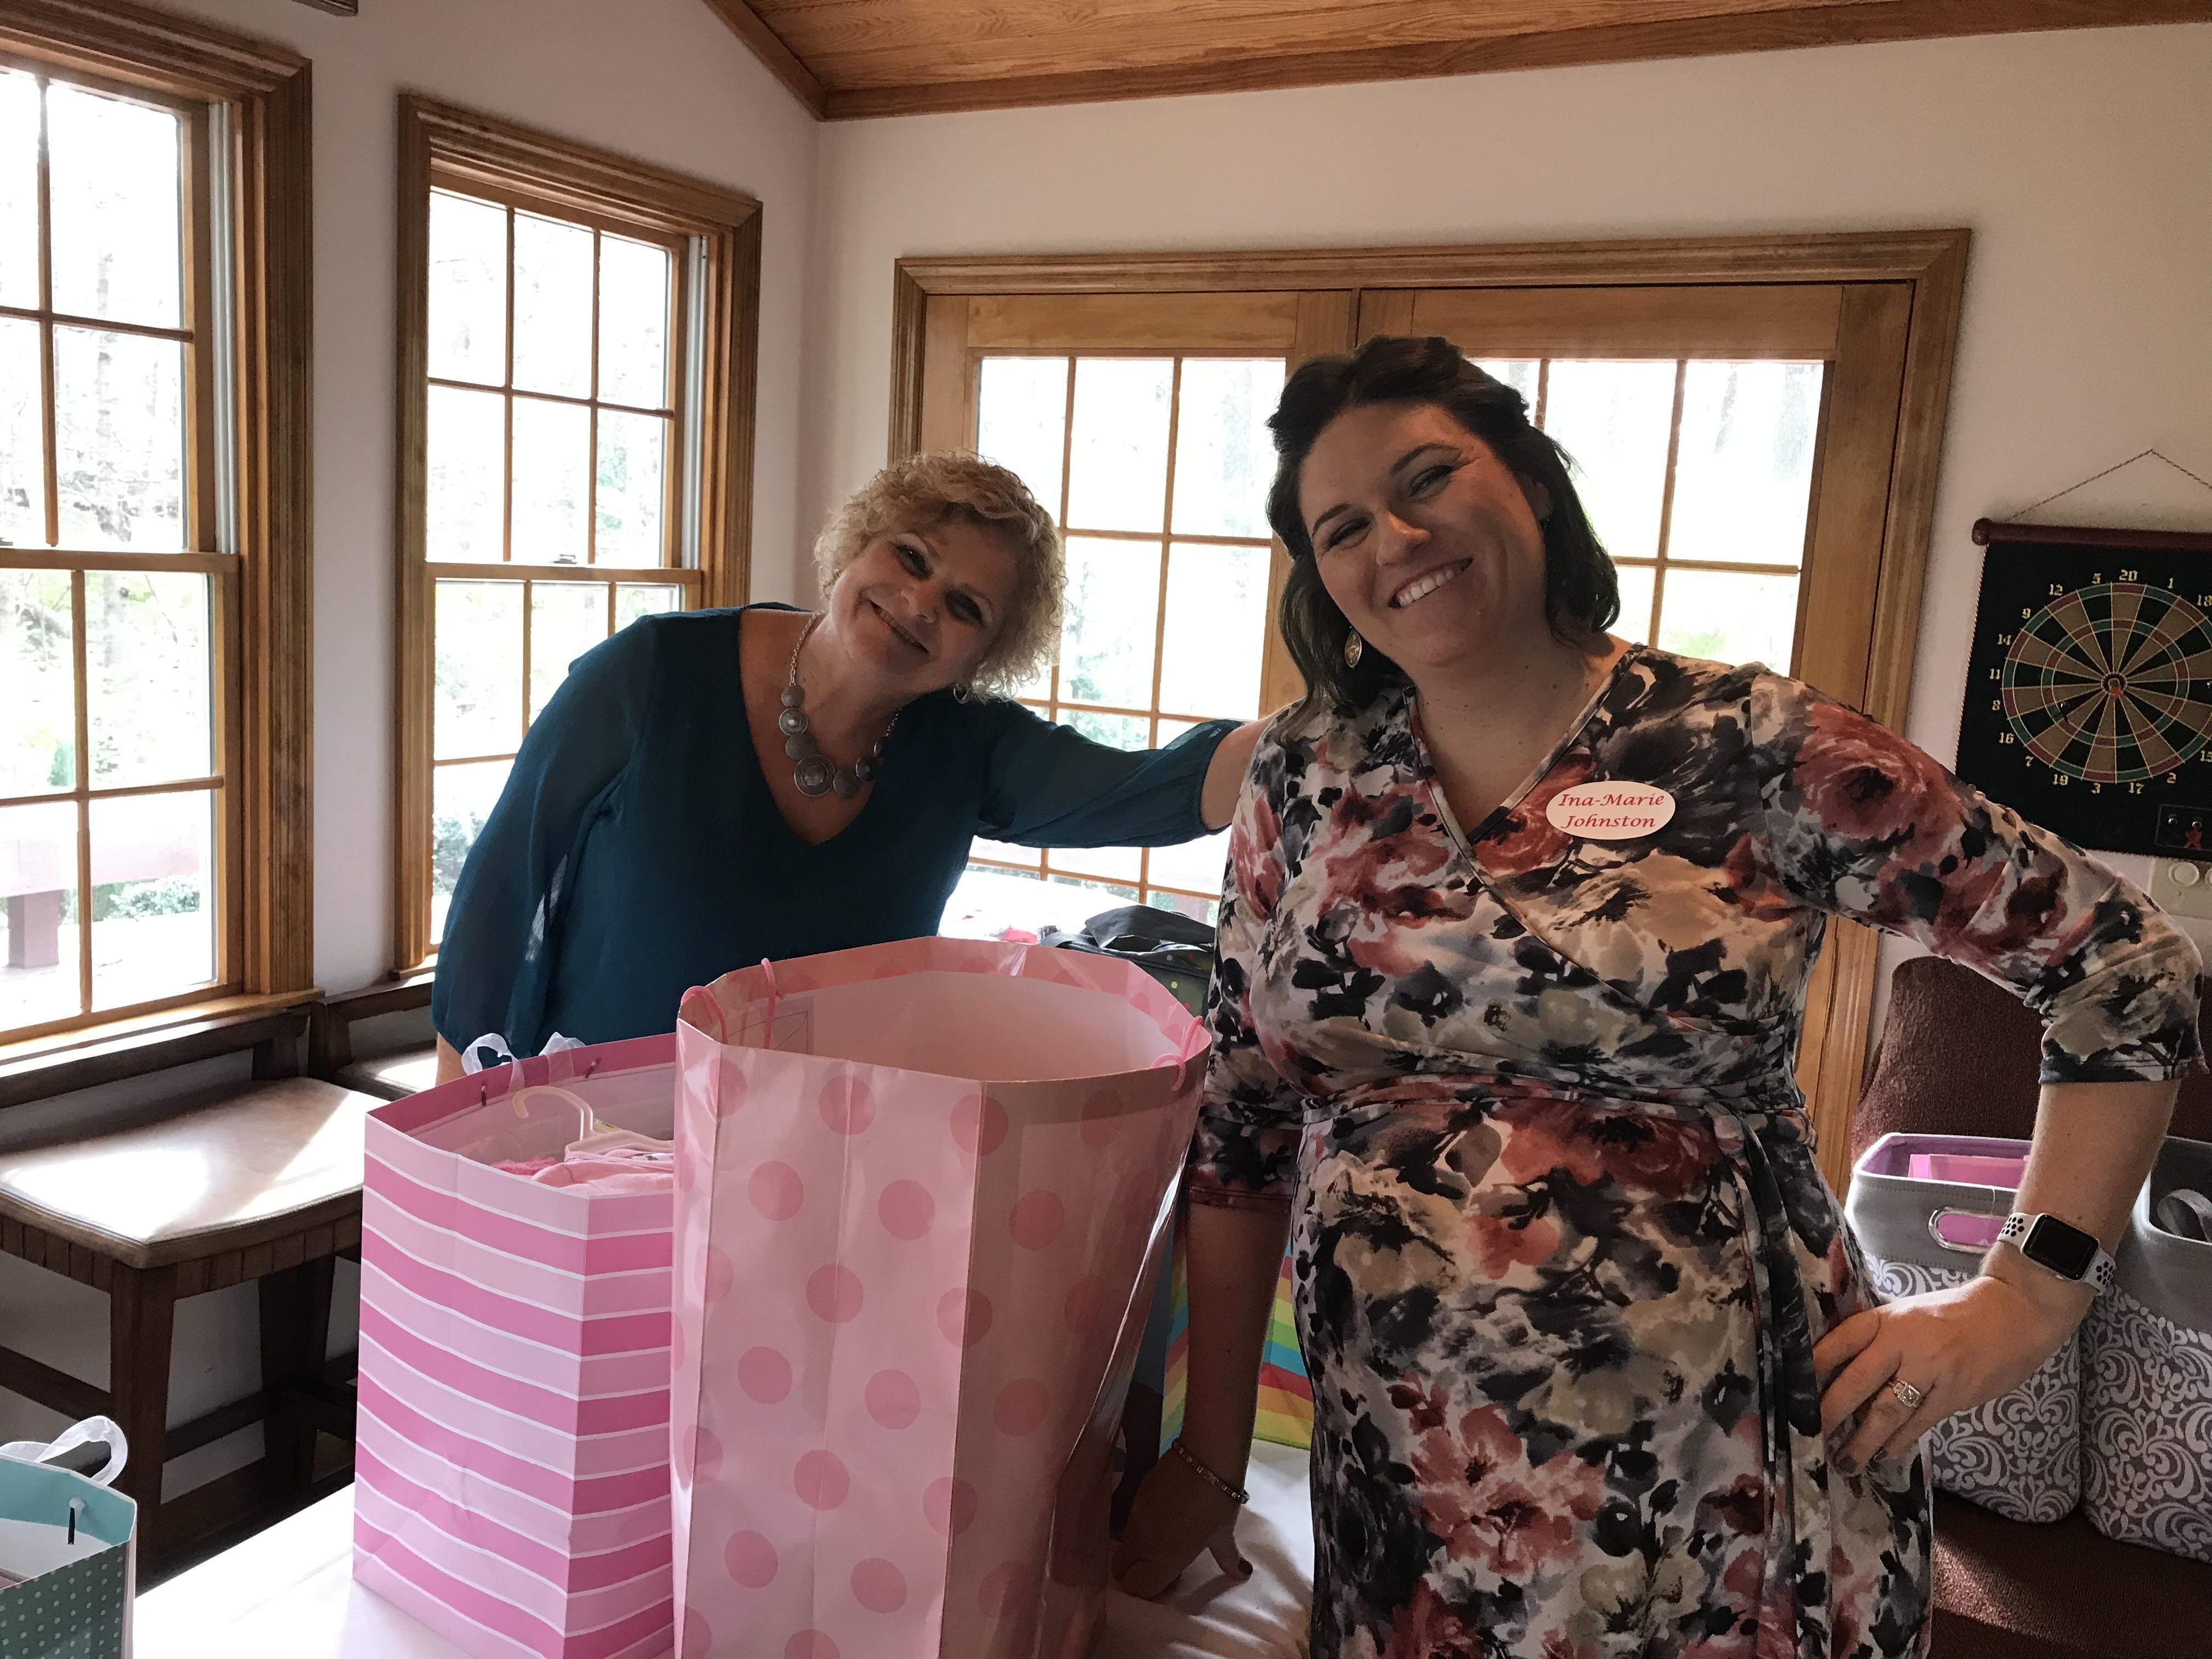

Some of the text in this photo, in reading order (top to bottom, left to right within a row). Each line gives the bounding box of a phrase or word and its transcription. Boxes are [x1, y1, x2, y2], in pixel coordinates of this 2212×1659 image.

[2091, 573, 2101, 584] 5
[2119, 568, 2138, 582] 20
[2168, 577, 2174, 589] 1
[2049, 584, 2063, 596] 12
[2197, 594, 2212, 607] 18
[2021, 607, 2031, 619] 9
[1997, 633, 2012, 646] 14
[1989, 668, 2001, 680] 11
[1991, 699, 2001, 711] 8
[1998, 732, 2015, 744] 16
[2025, 755, 2034, 768] 7
[2200, 749, 2212, 763] 15
[2052, 774, 2068, 786] 19
[2166, 772, 2177, 784] 2
[2090, 782, 2101, 794] 3
[2128, 782, 2145, 795] 17
[1558, 794, 1664, 806] Ina-Marie
[1561, 814, 1655, 829] Johnston
